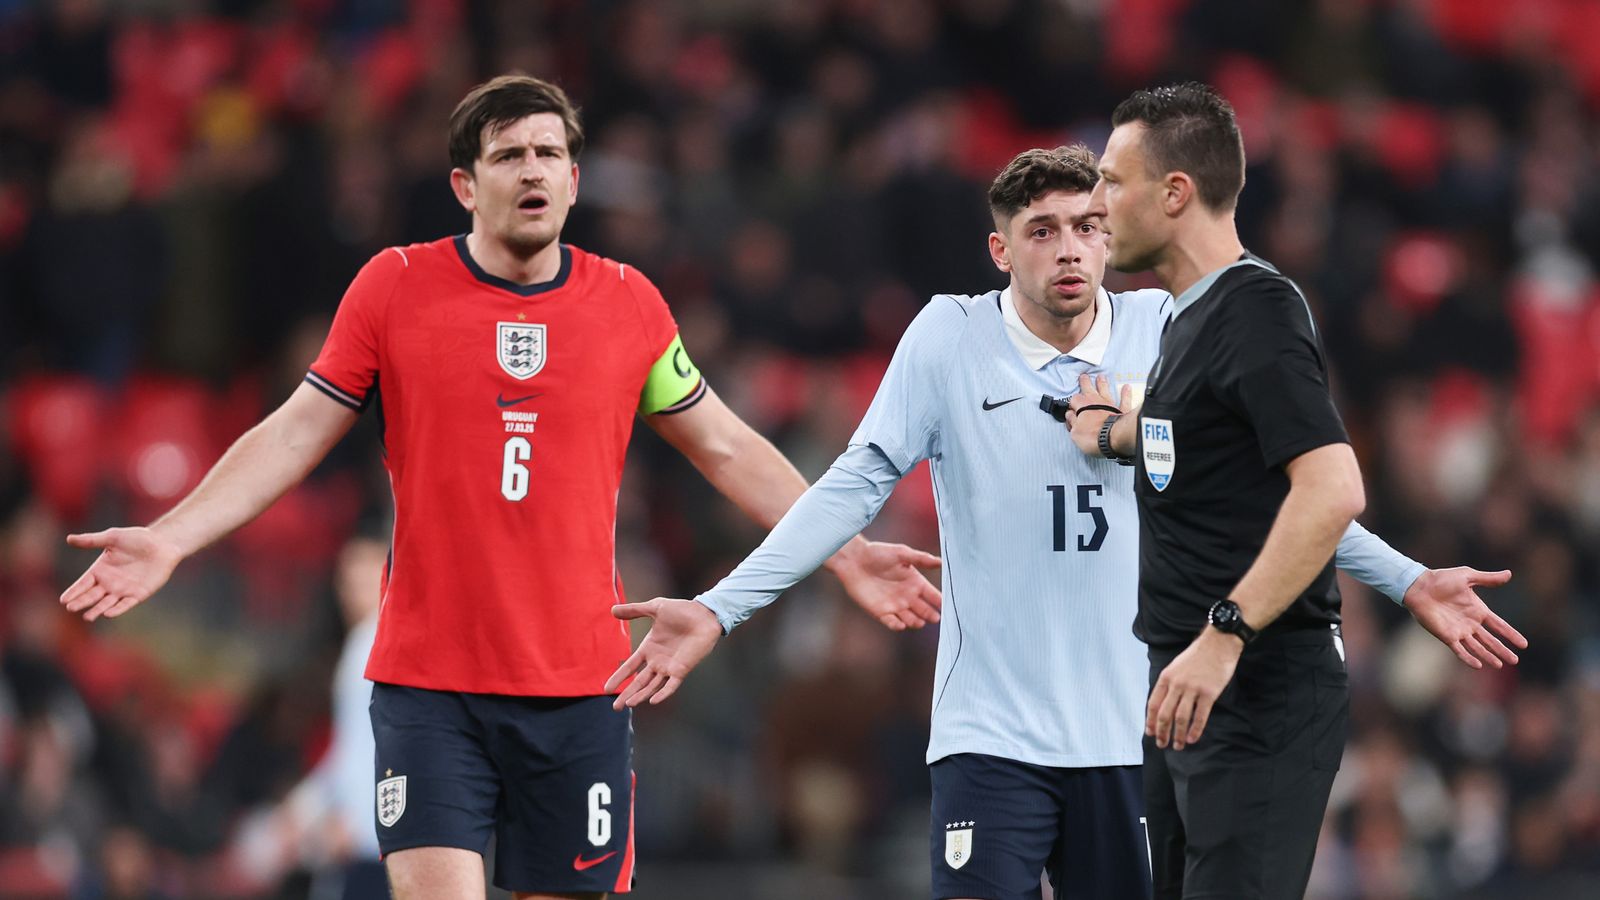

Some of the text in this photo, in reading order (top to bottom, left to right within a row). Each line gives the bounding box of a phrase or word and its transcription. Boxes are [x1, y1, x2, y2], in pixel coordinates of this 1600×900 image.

[673, 346, 691, 378] C
[502, 411, 538, 422] URUGUAY
[1145, 423, 1170, 441] FIFA
[501, 436, 532, 502] 6
[1146, 451, 1172, 462] REFEREE
[1046, 484, 1109, 551] 15
[587, 782, 612, 847] 6
